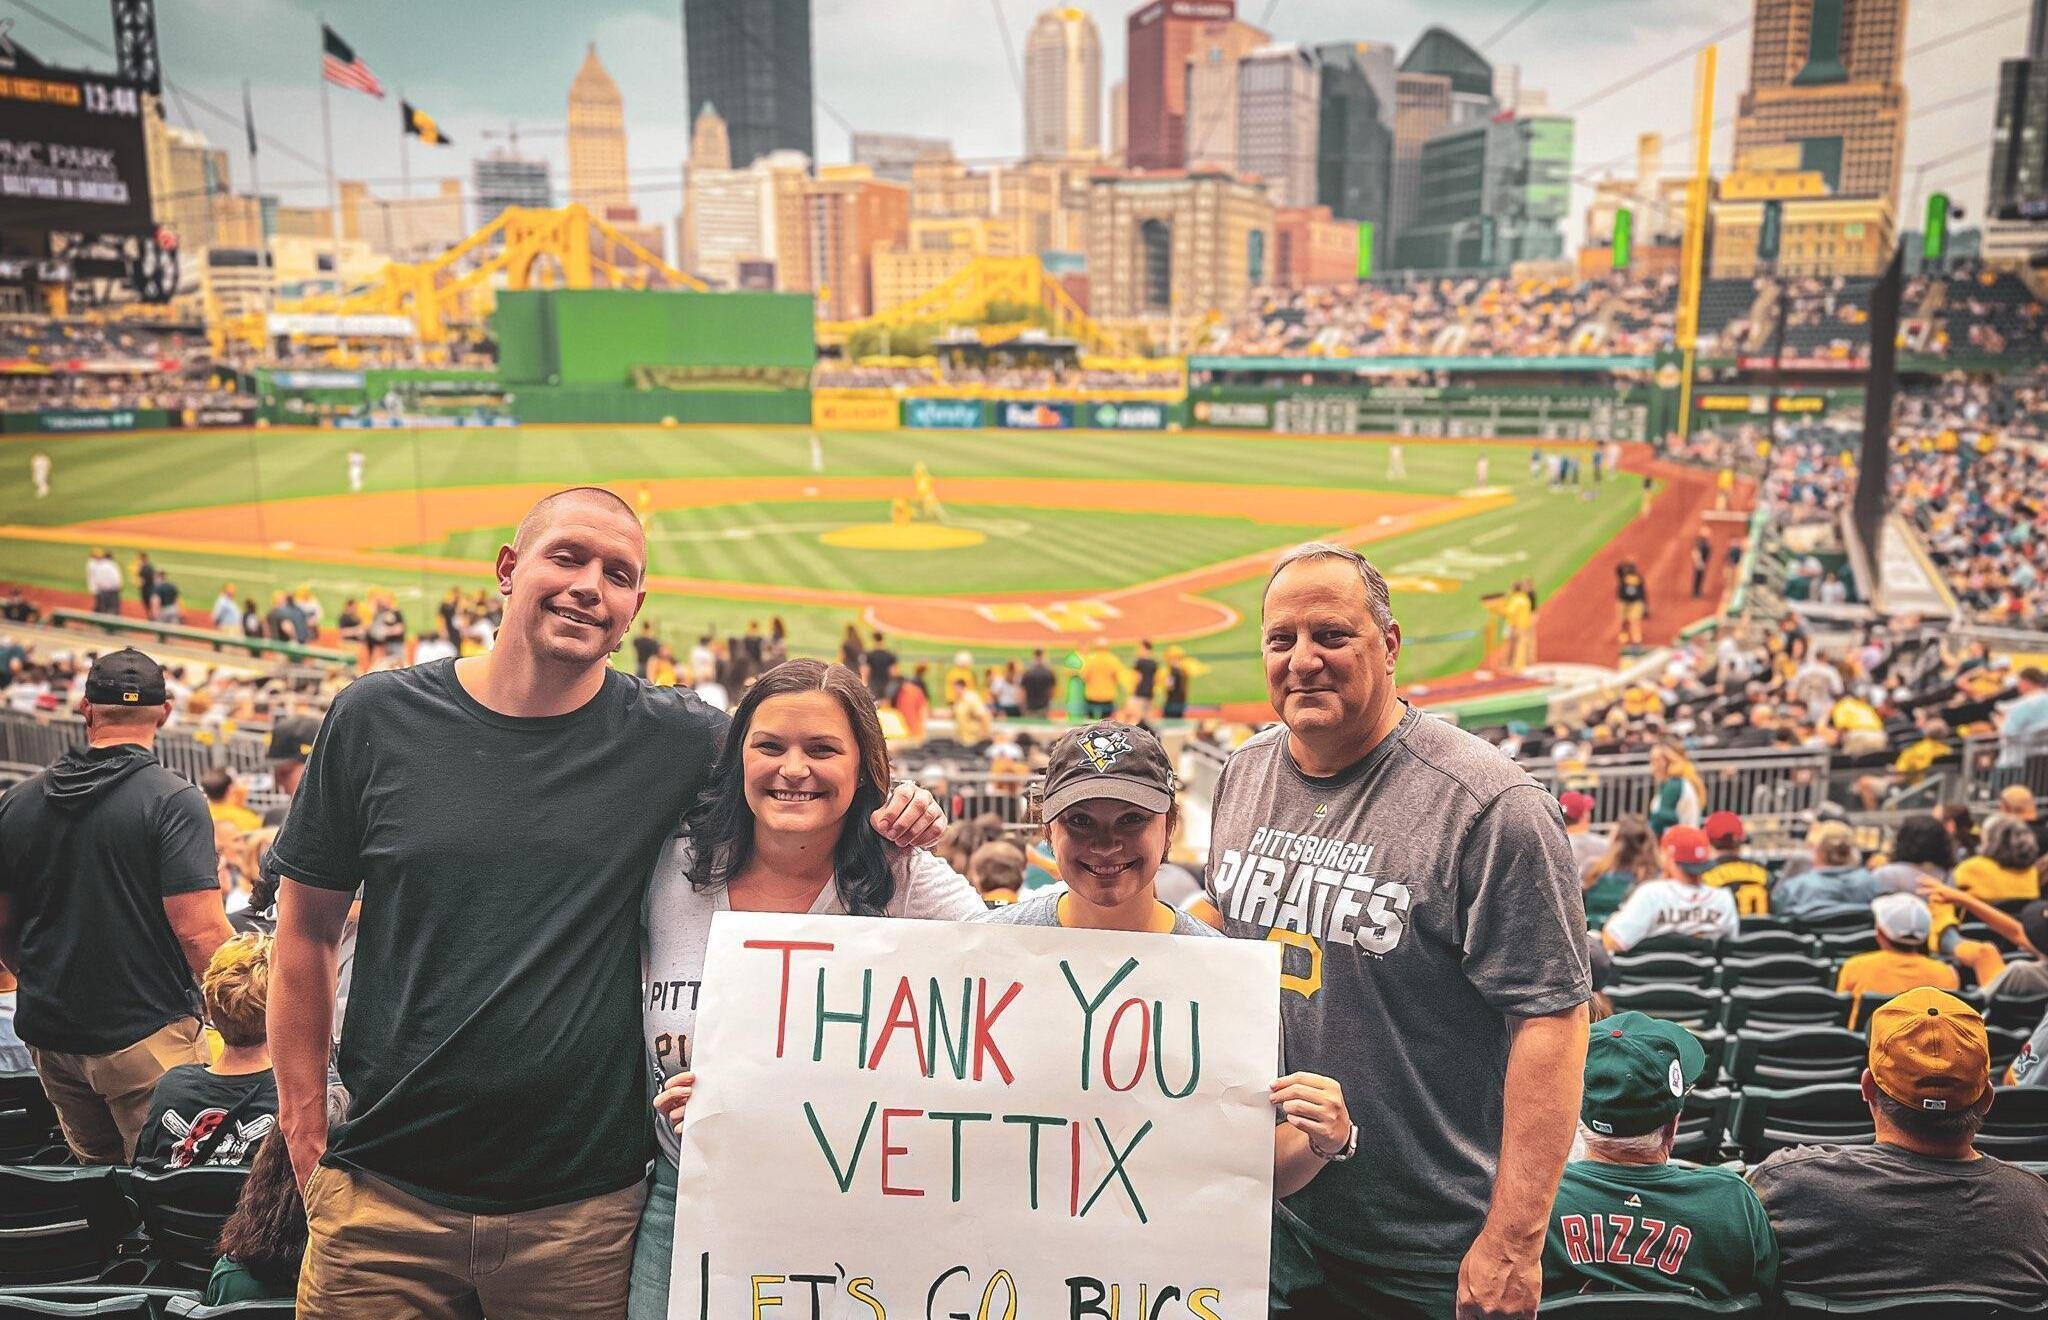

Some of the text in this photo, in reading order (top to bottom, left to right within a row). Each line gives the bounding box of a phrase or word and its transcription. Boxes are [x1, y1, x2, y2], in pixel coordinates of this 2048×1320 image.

[1248, 826, 1374, 874] PITTSBURGH
[1214, 849, 1411, 955] PIRATES
[743, 940, 1200, 1099] THANK YOU
[804, 1101, 1154, 1224] VETTIX
[1560, 1213, 1693, 1275] RIZZO
[926, 1265, 1018, 1320] GO
[1064, 1275, 1221, 1320] BUCS
